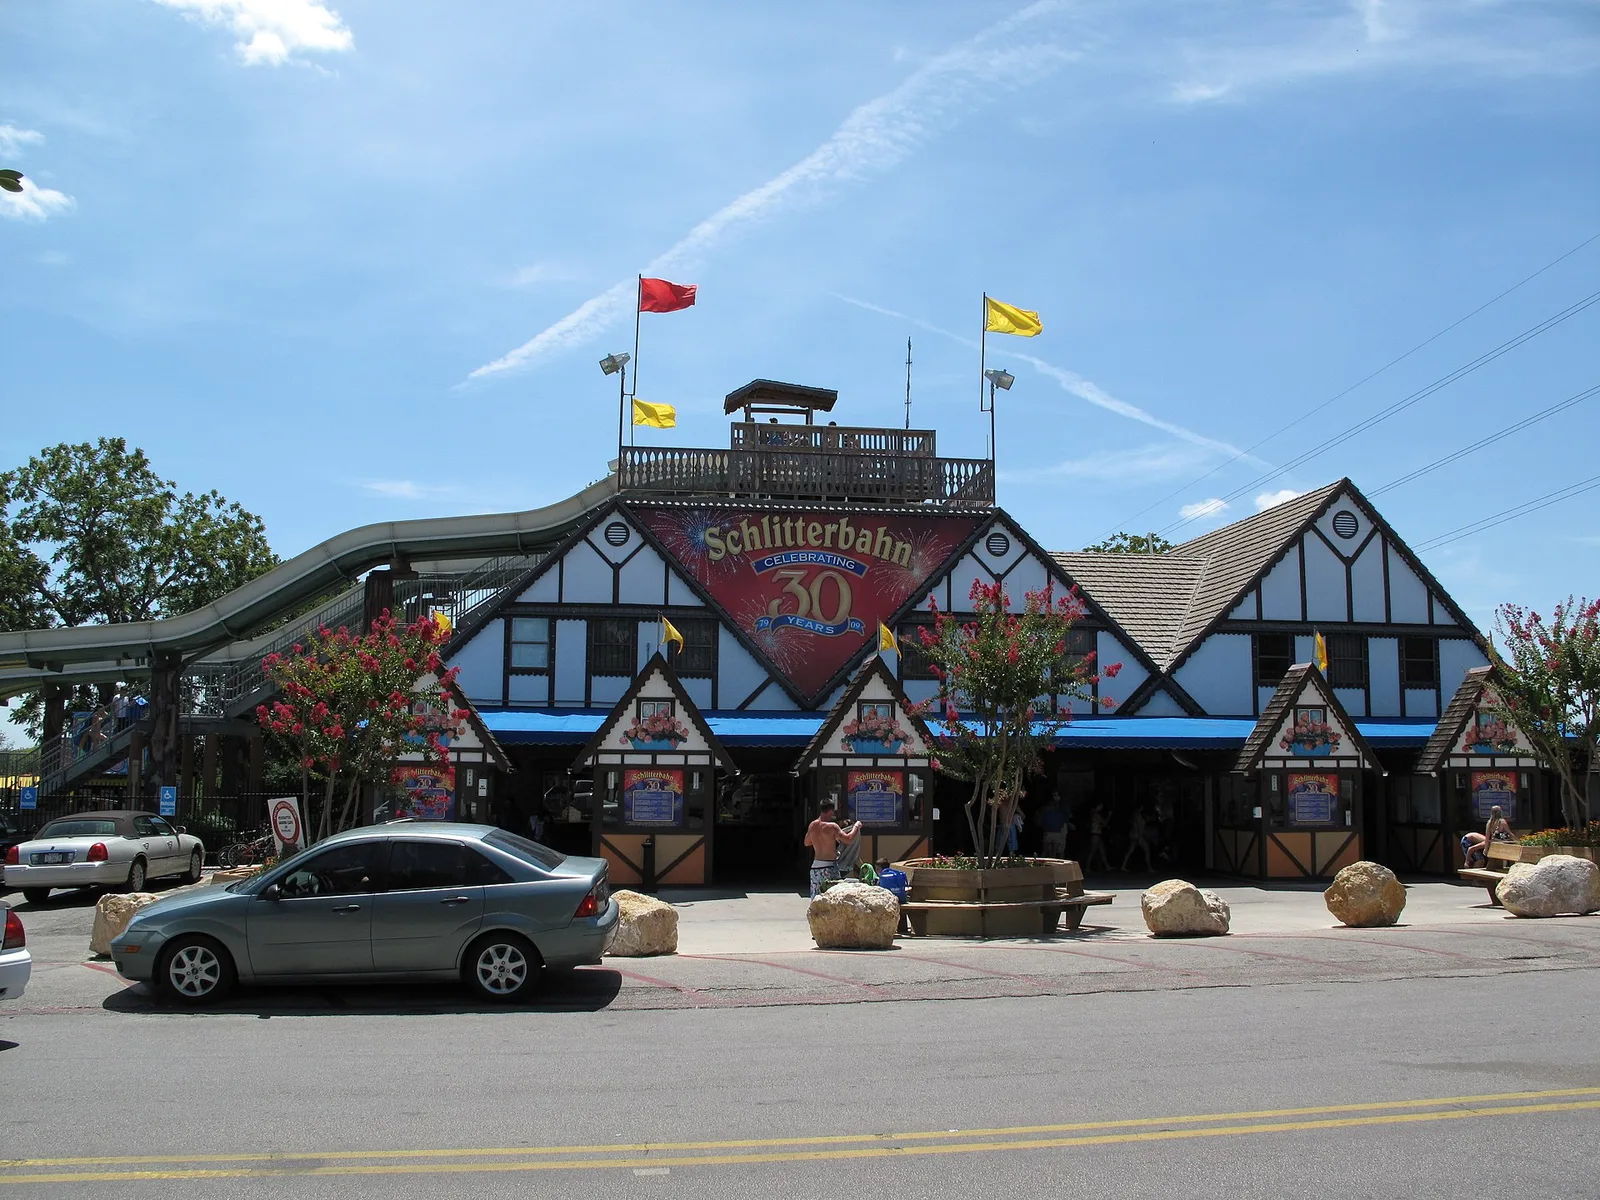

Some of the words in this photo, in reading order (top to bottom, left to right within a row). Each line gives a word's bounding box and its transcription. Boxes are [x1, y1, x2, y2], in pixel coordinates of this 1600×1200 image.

[704, 515, 914, 568] Schlitterbahn
[764, 553, 855, 570] CELEBRATING
[768, 569, 852, 625] 30
[759, 619, 770, 628] 79
[787, 616, 835, 635] YEARS
[850, 621, 861, 630] 09
[631, 771, 674, 782] Schlitterbahn
[854, 772, 896, 783] Schlitterbahn
[417, 778, 432, 788] 30
[646, 780, 660, 790] 30
[868, 782, 882, 791] 30
